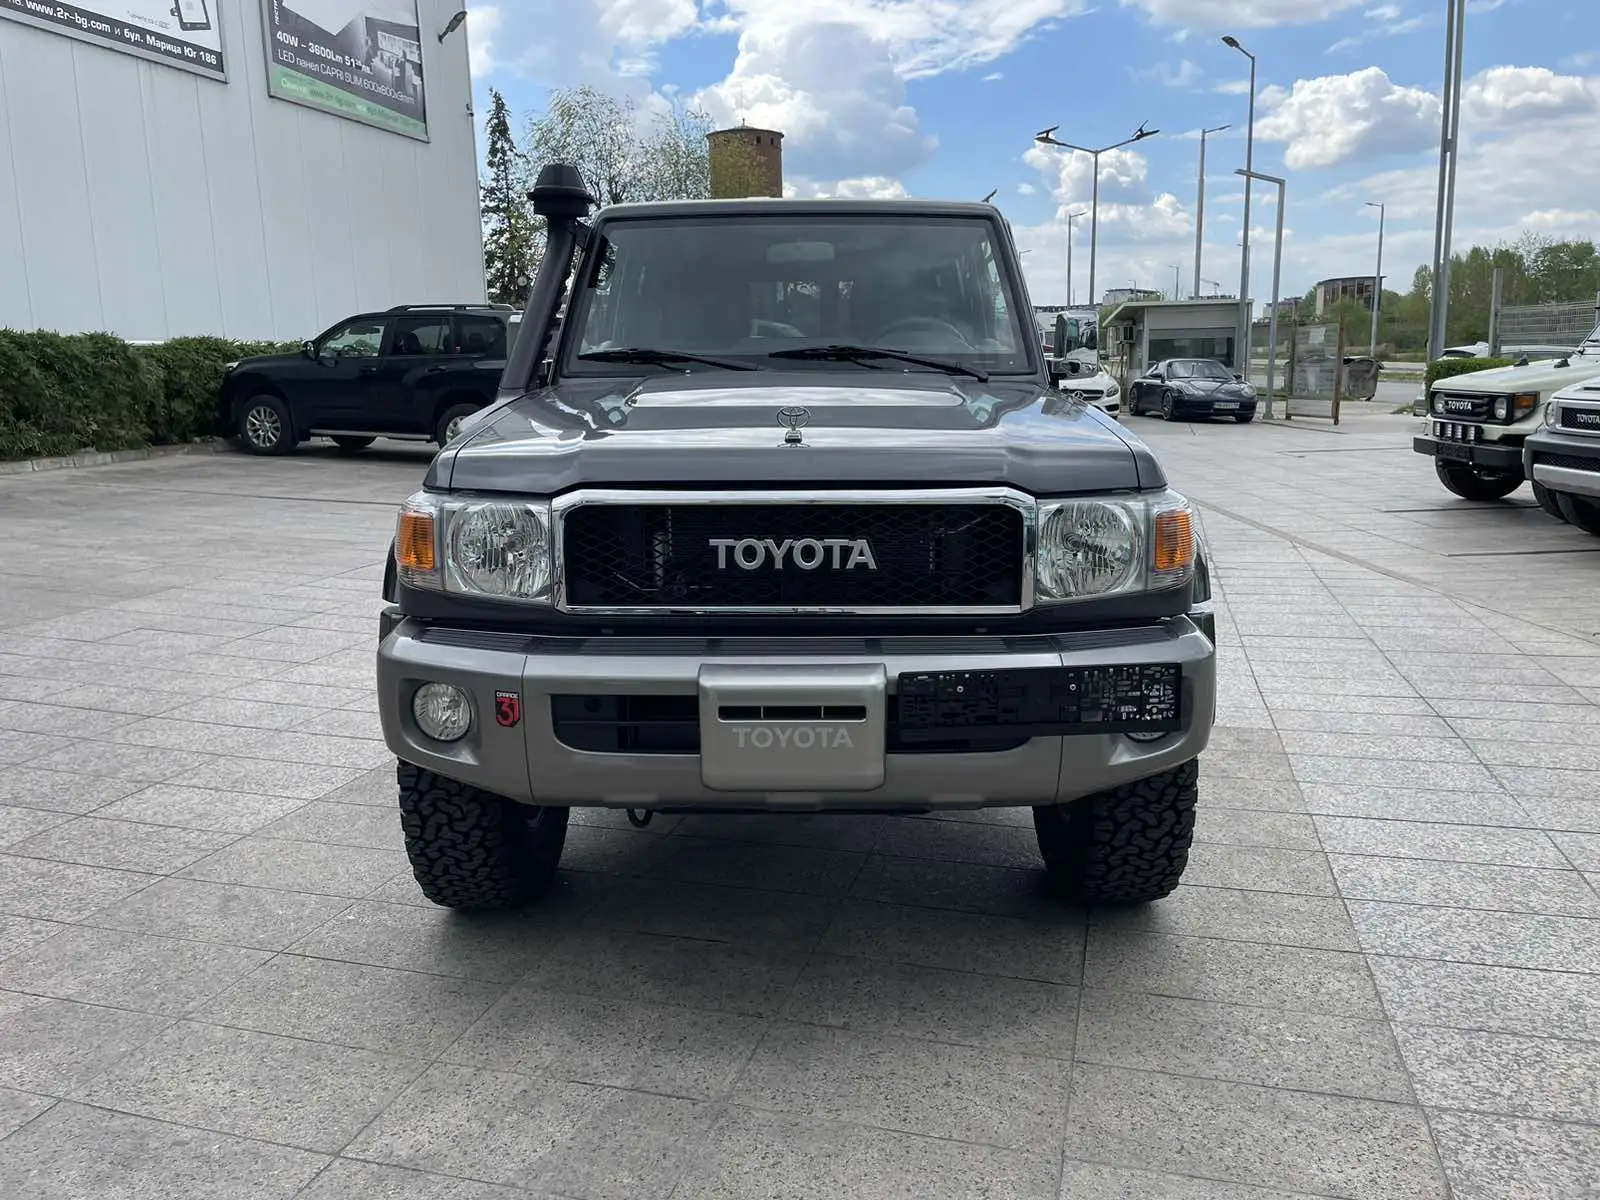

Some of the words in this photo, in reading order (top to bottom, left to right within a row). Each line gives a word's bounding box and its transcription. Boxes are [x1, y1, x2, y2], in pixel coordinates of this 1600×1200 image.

[25, 0, 111, 33] www.2r-bg.com
[123, 27, 144, 42] бул.
[146, 34, 182, 55] Марица
[183, 46, 197, 58] Юг
[200, 51, 217, 65] 186
[276, 31, 299, 47] 40W
[308, 43, 343, 62] 3600Lm
[278, 50, 295, 64] LED
[296, 57, 320, 72] панел
[320, 63, 344, 81] CAPRI
[1448, 400, 1472, 411] TOYOTA
[1576, 413, 1600, 424] TOYOTA
[709, 538, 877, 570] TOYOTA
[731, 726, 854, 749] TOYOTA
